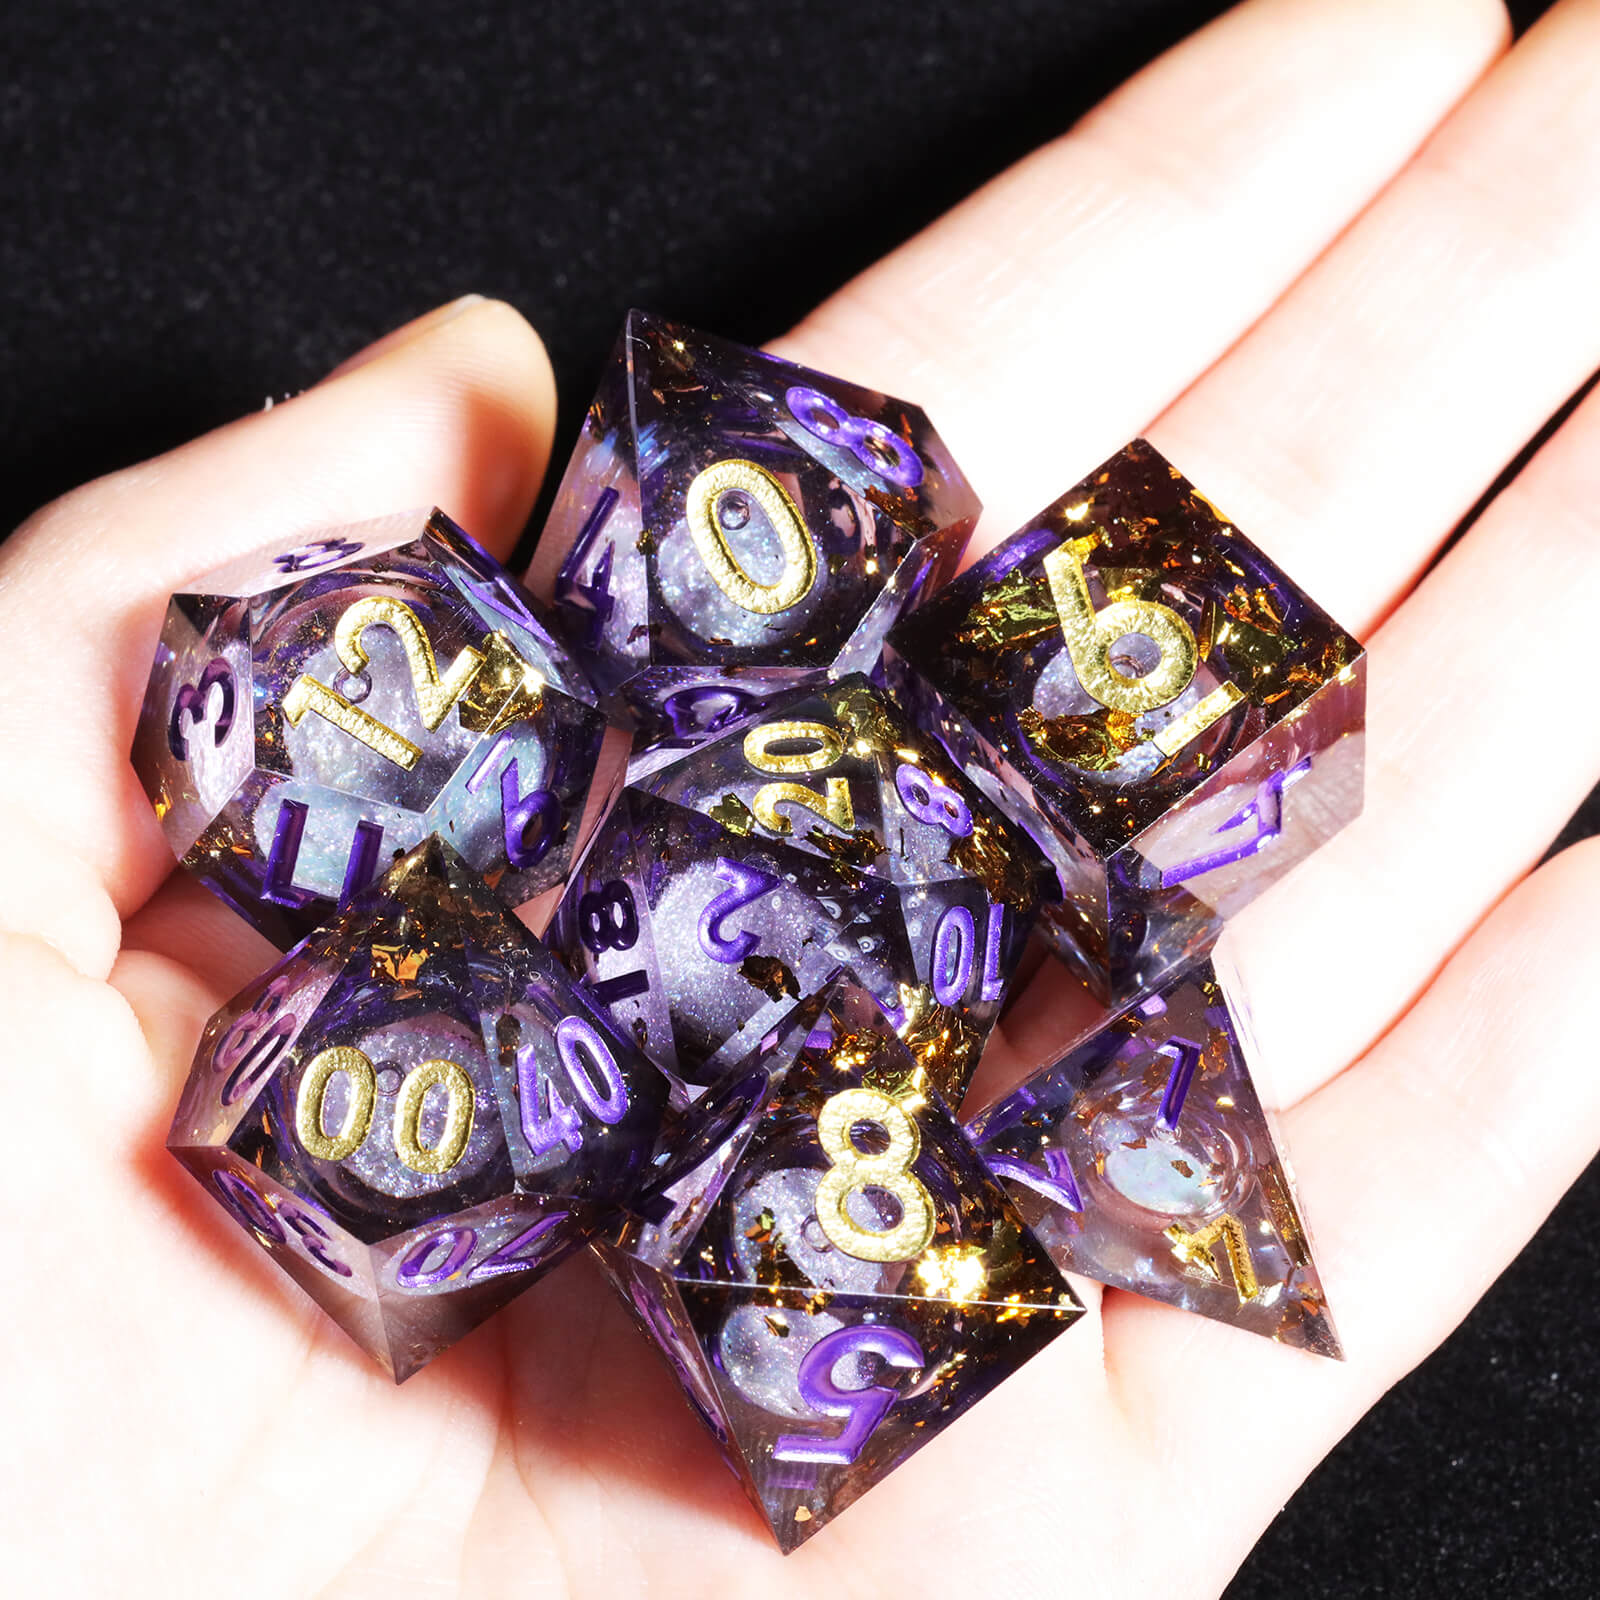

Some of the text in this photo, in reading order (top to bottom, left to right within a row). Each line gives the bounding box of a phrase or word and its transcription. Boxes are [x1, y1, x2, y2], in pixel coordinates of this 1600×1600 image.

[786, 386, 924, 487] 8
[555, 487, 624, 640] 4
[686, 459, 816, 614] 0
[168, 657, 238, 762] 3
[282, 597, 486, 771] 12
[1043, 538, 1246, 758] 6
[743, 721, 855, 836] 20
[896, 763, 974, 837] 8
[1162, 757, 1312, 888] 4
[697, 856, 781, 964] 2
[928, 903, 1005, 1006] 10
[296, 1046, 476, 1175] 00
[516, 1015, 629, 1156] 40
[815, 1088, 936, 1262] 8
[396, 1210, 571, 1288] 70
[771, 1324, 926, 1466] 5
